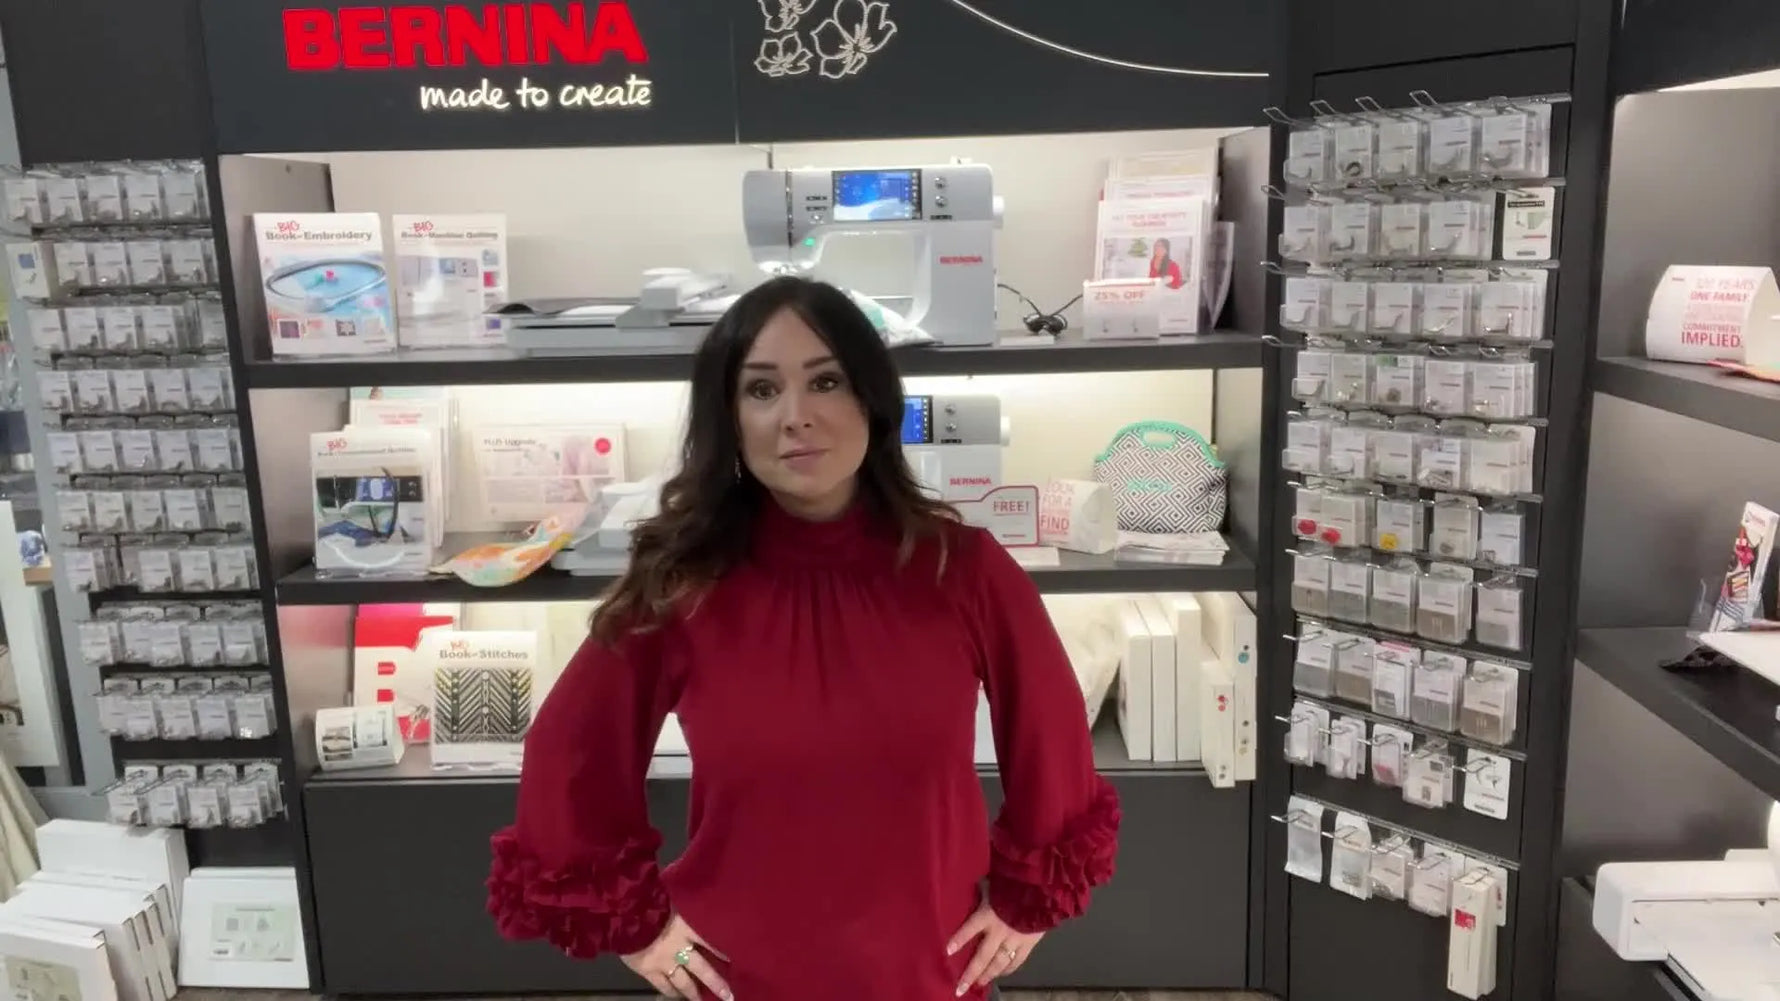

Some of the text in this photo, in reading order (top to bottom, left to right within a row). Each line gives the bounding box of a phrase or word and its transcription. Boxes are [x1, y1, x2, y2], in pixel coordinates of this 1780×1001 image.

[283, 2, 649, 70] BERNINA
[420, 74, 653, 110] made to create
[265, 231, 298, 241] Book
[304, 231, 373, 242] Embroidery
[949, 477, 992, 486] BERNINA
[992, 500, 1030, 513] FREE!
[1040, 514, 1070, 531] FIND
[439, 649, 471, 660] Book
[479, 648, 529, 660] Stitches
